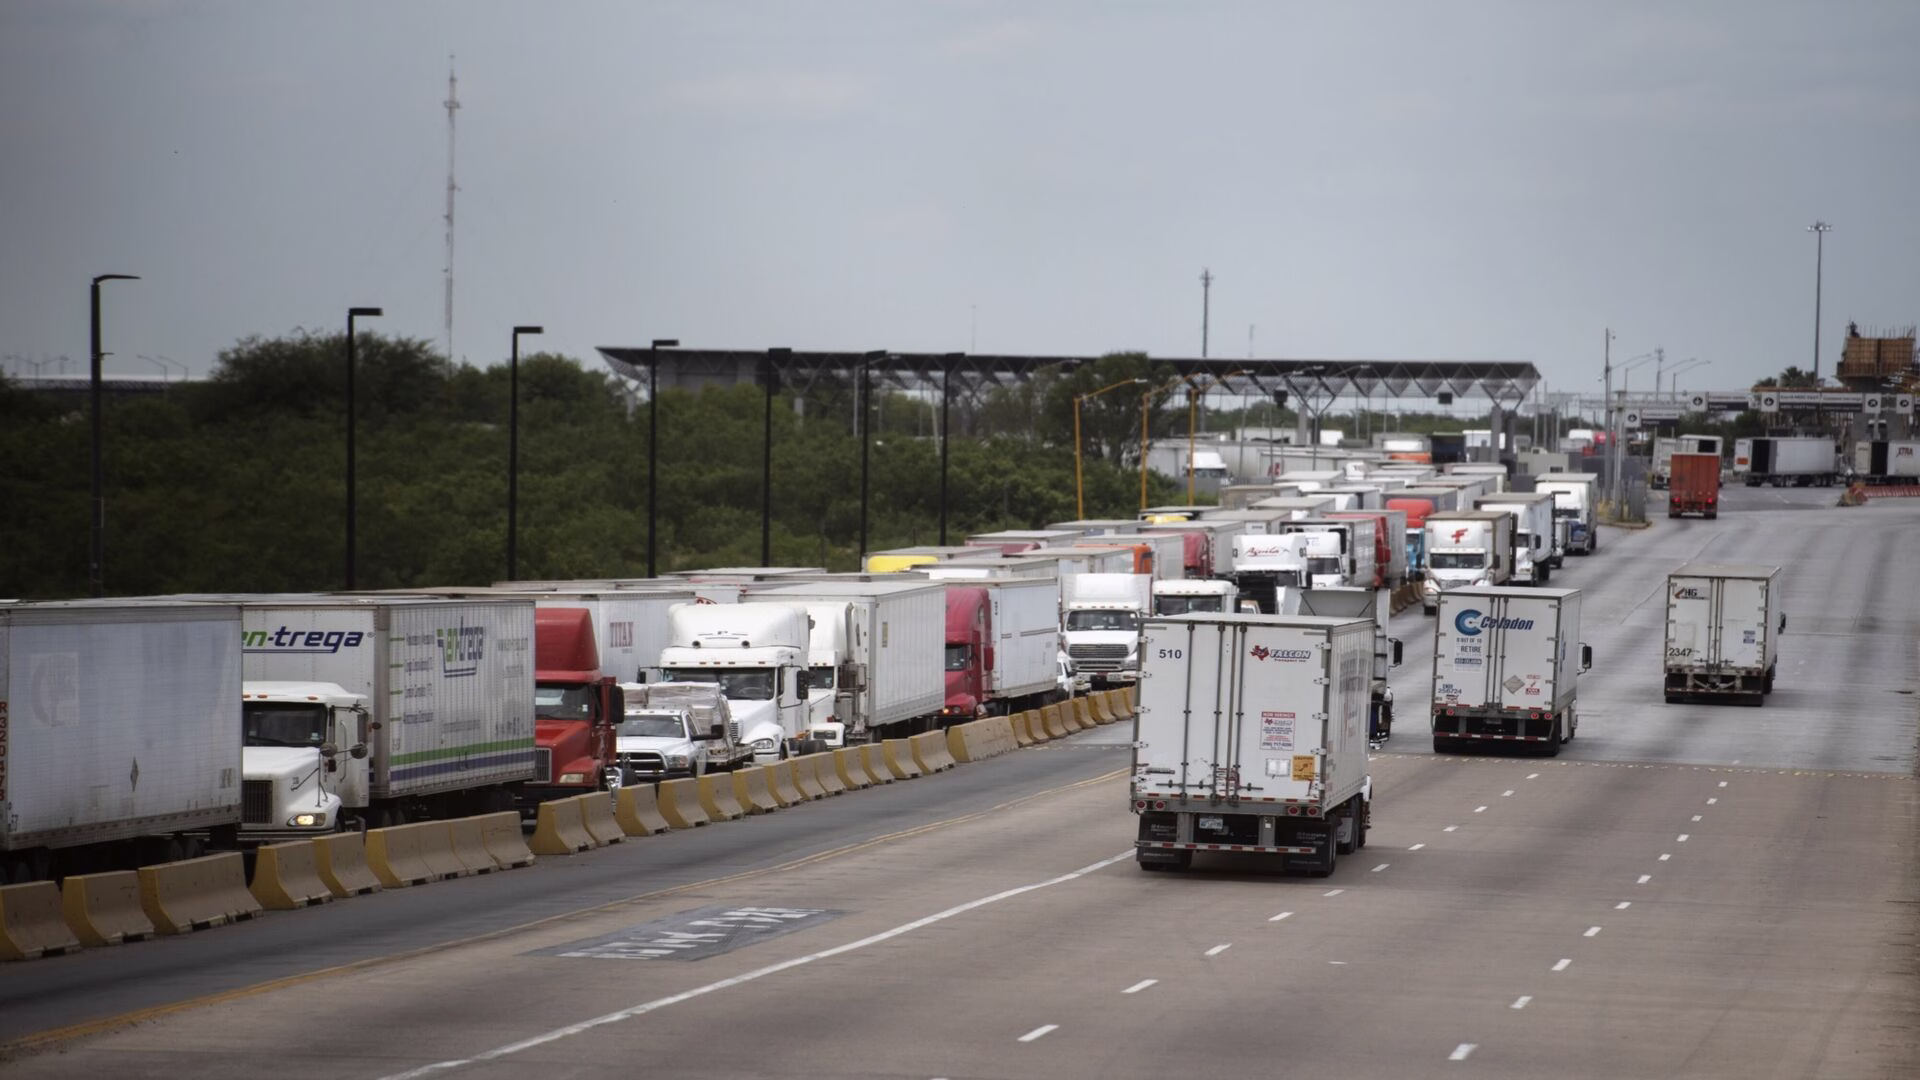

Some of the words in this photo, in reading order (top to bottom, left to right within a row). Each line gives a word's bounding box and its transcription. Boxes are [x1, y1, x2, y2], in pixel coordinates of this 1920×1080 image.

[1480, 616, 1534, 630] Celadon
[609, 621, 634, 648] TITAN
[1159, 649, 1182, 659] 510
[1270, 649, 1311, 659] FALCON
[1668, 648, 1692, 657] 2347
